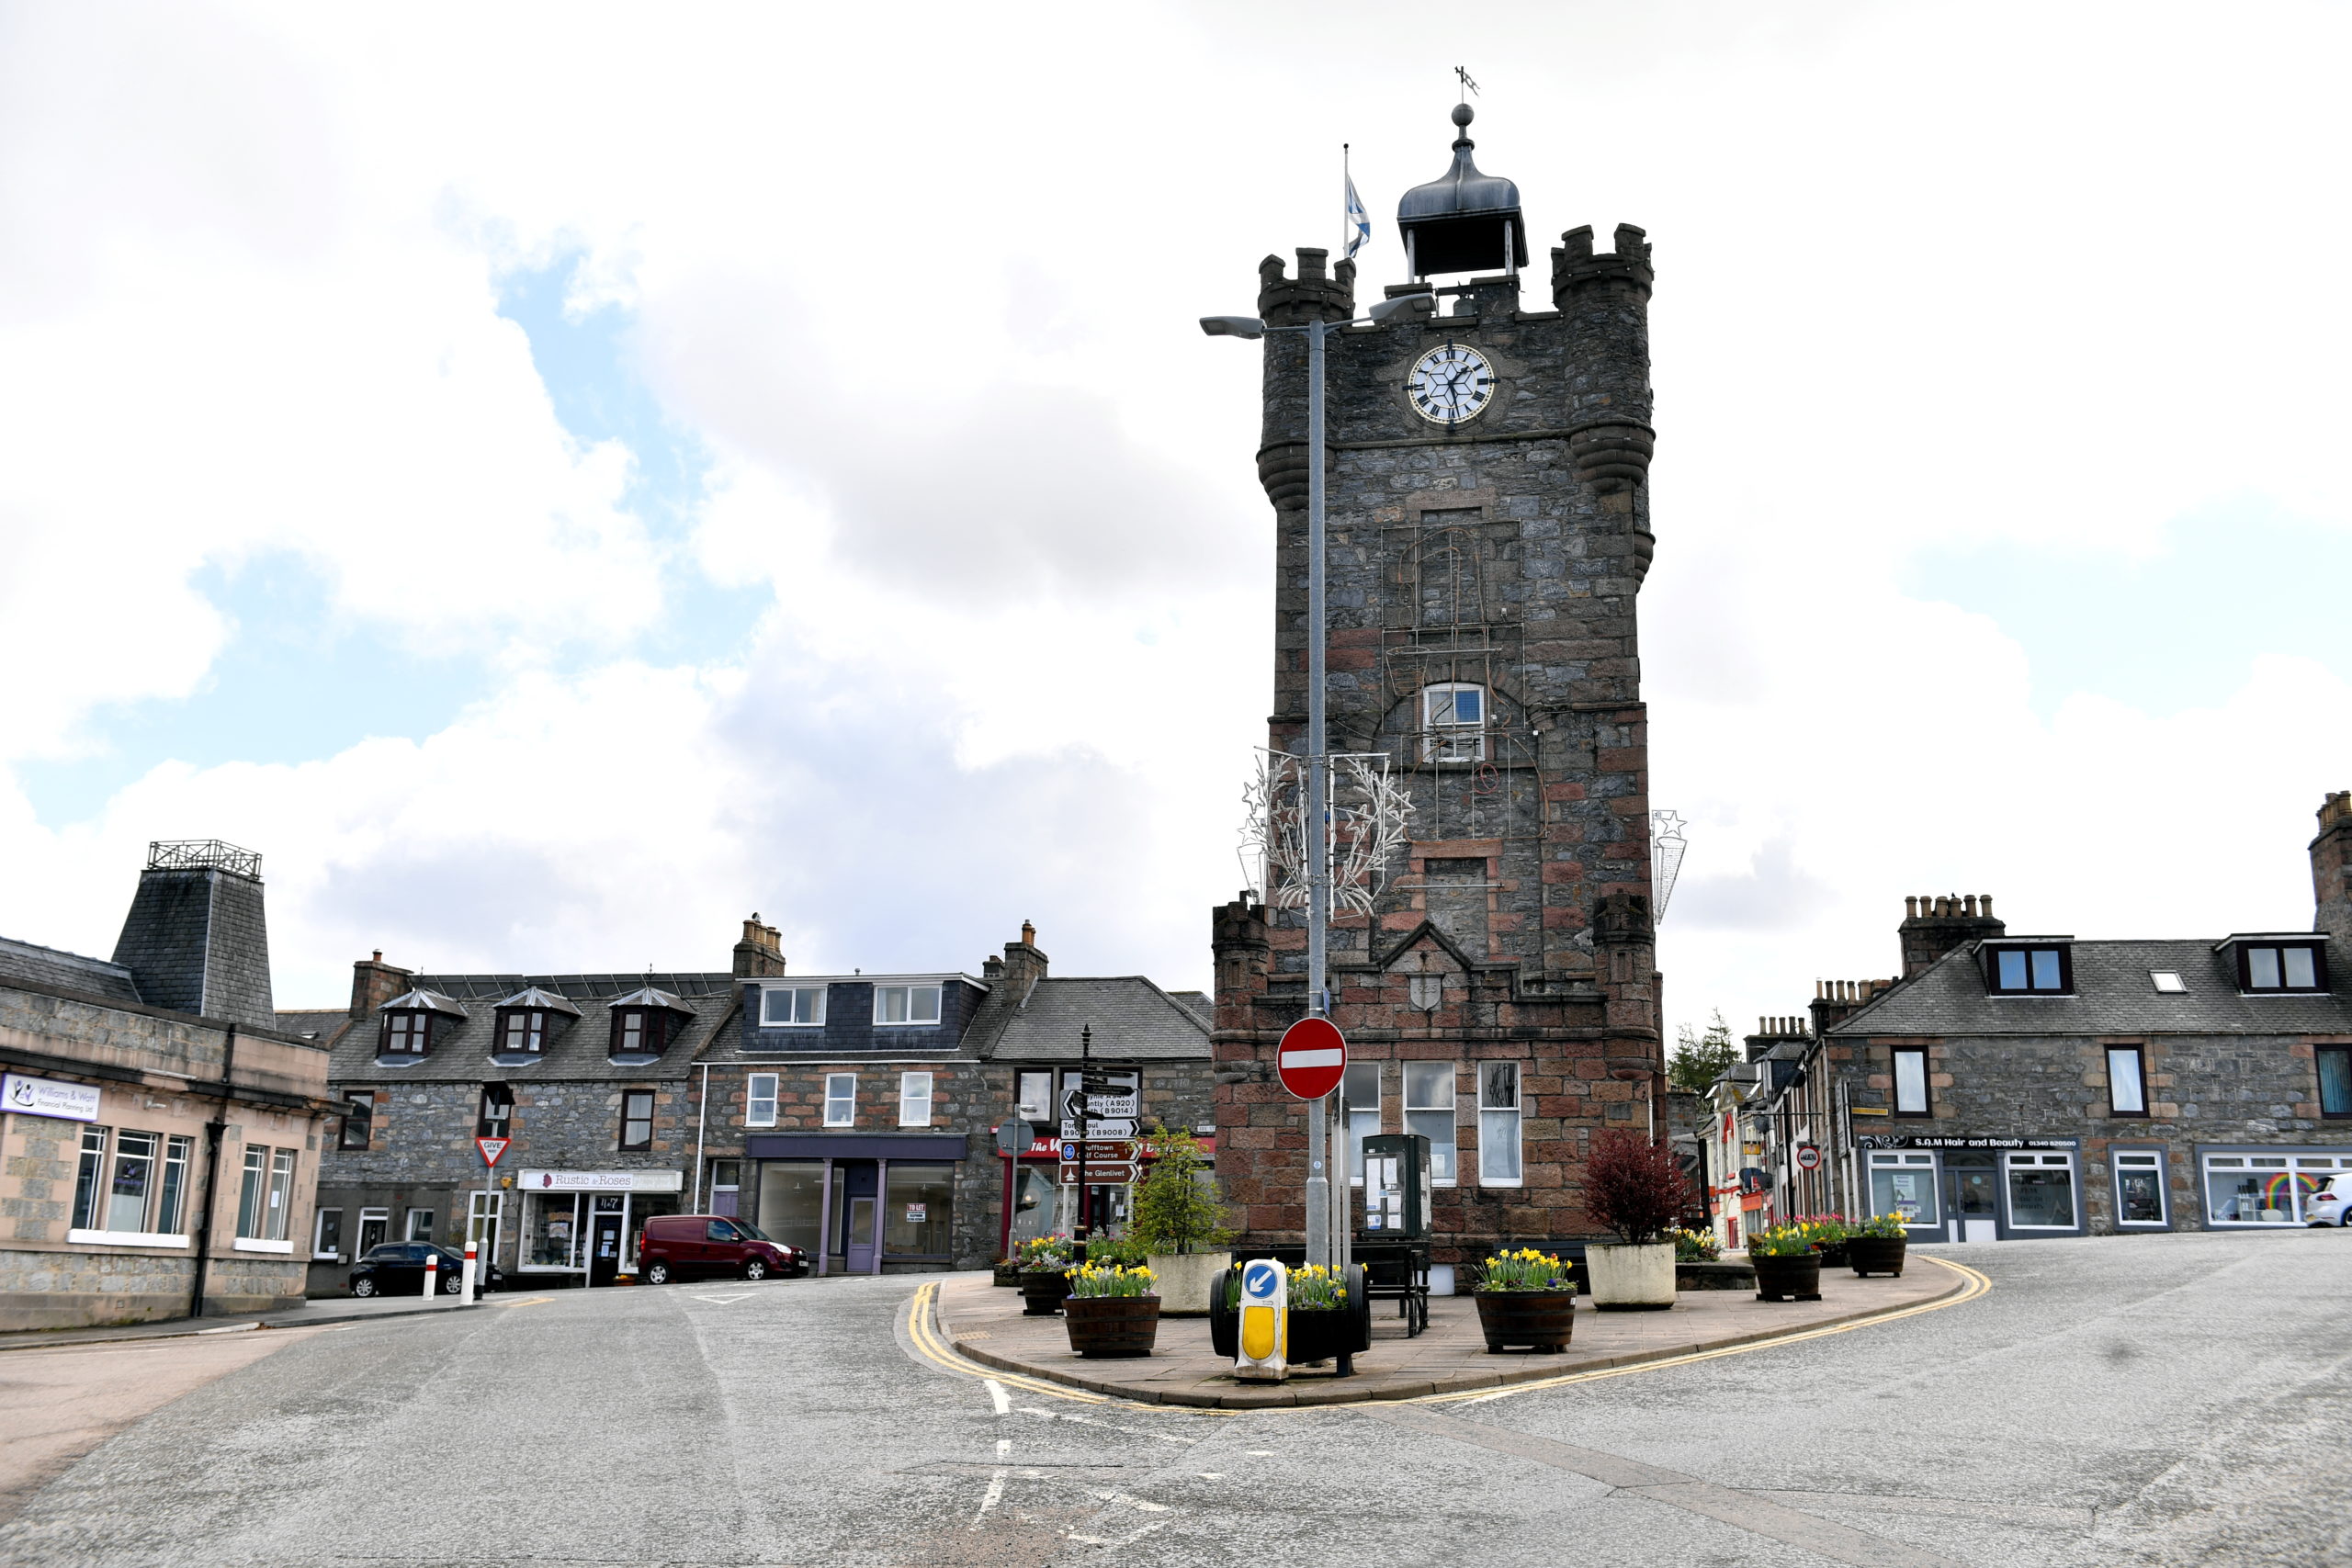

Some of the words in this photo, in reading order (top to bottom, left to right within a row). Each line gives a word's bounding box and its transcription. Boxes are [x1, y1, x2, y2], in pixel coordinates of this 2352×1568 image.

[38, 1086, 69, 1100] Williams
[70, 1090, 76, 1100] &
[38, 1099, 61, 1109] Financial
[62, 1102, 84, 1113] Planning
[1030, 1142, 1047, 1153] The
[1915, 1138, 1942, 1146] S.A.M
[1944, 1138, 1965, 1146] Hair
[1968, 1138, 1988, 1147] and
[1989, 1138, 2024, 1149] Beauty
[555, 1175, 590, 1186] Rustic
[598, 1175, 631, 1186] Roses
